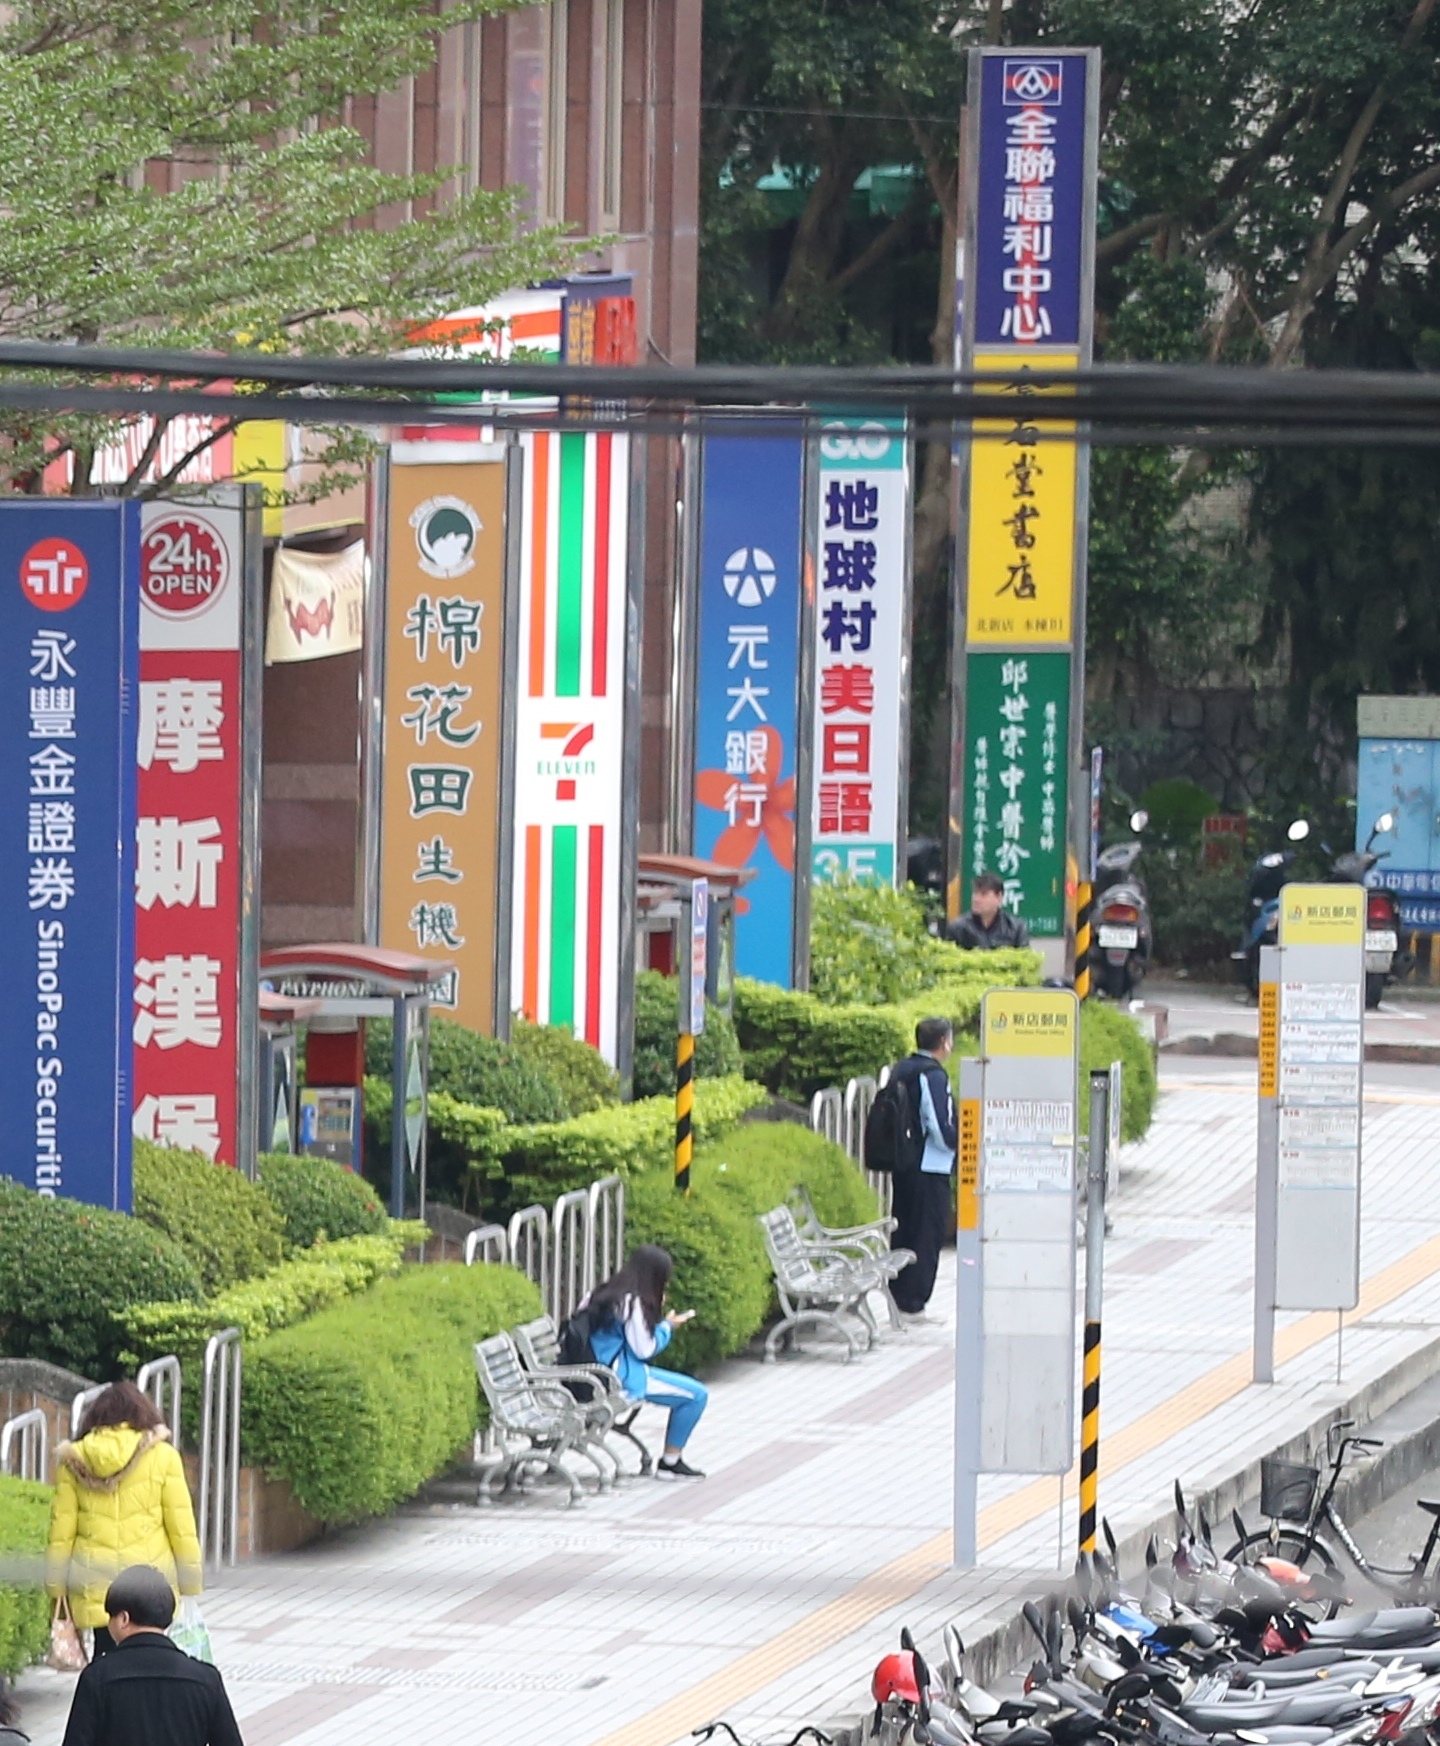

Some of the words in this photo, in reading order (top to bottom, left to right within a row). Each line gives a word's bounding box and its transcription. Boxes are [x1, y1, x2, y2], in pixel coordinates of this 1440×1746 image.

[1000, 109, 1057, 343] 全聯福利中心
[148, 575, 212, 596] OPEN
[149, 532, 212, 573] 24h
[817, 480, 882, 836] 地球村美日語
[27, 629, 78, 911] 永豐金證券
[723, 623, 771, 829] 元大銀行
[37, 919, 64, 1050] SinoPac
[280, 977, 371, 998] PAYPHONE
[1013, 1012, 1068, 1026] 新店郵局
